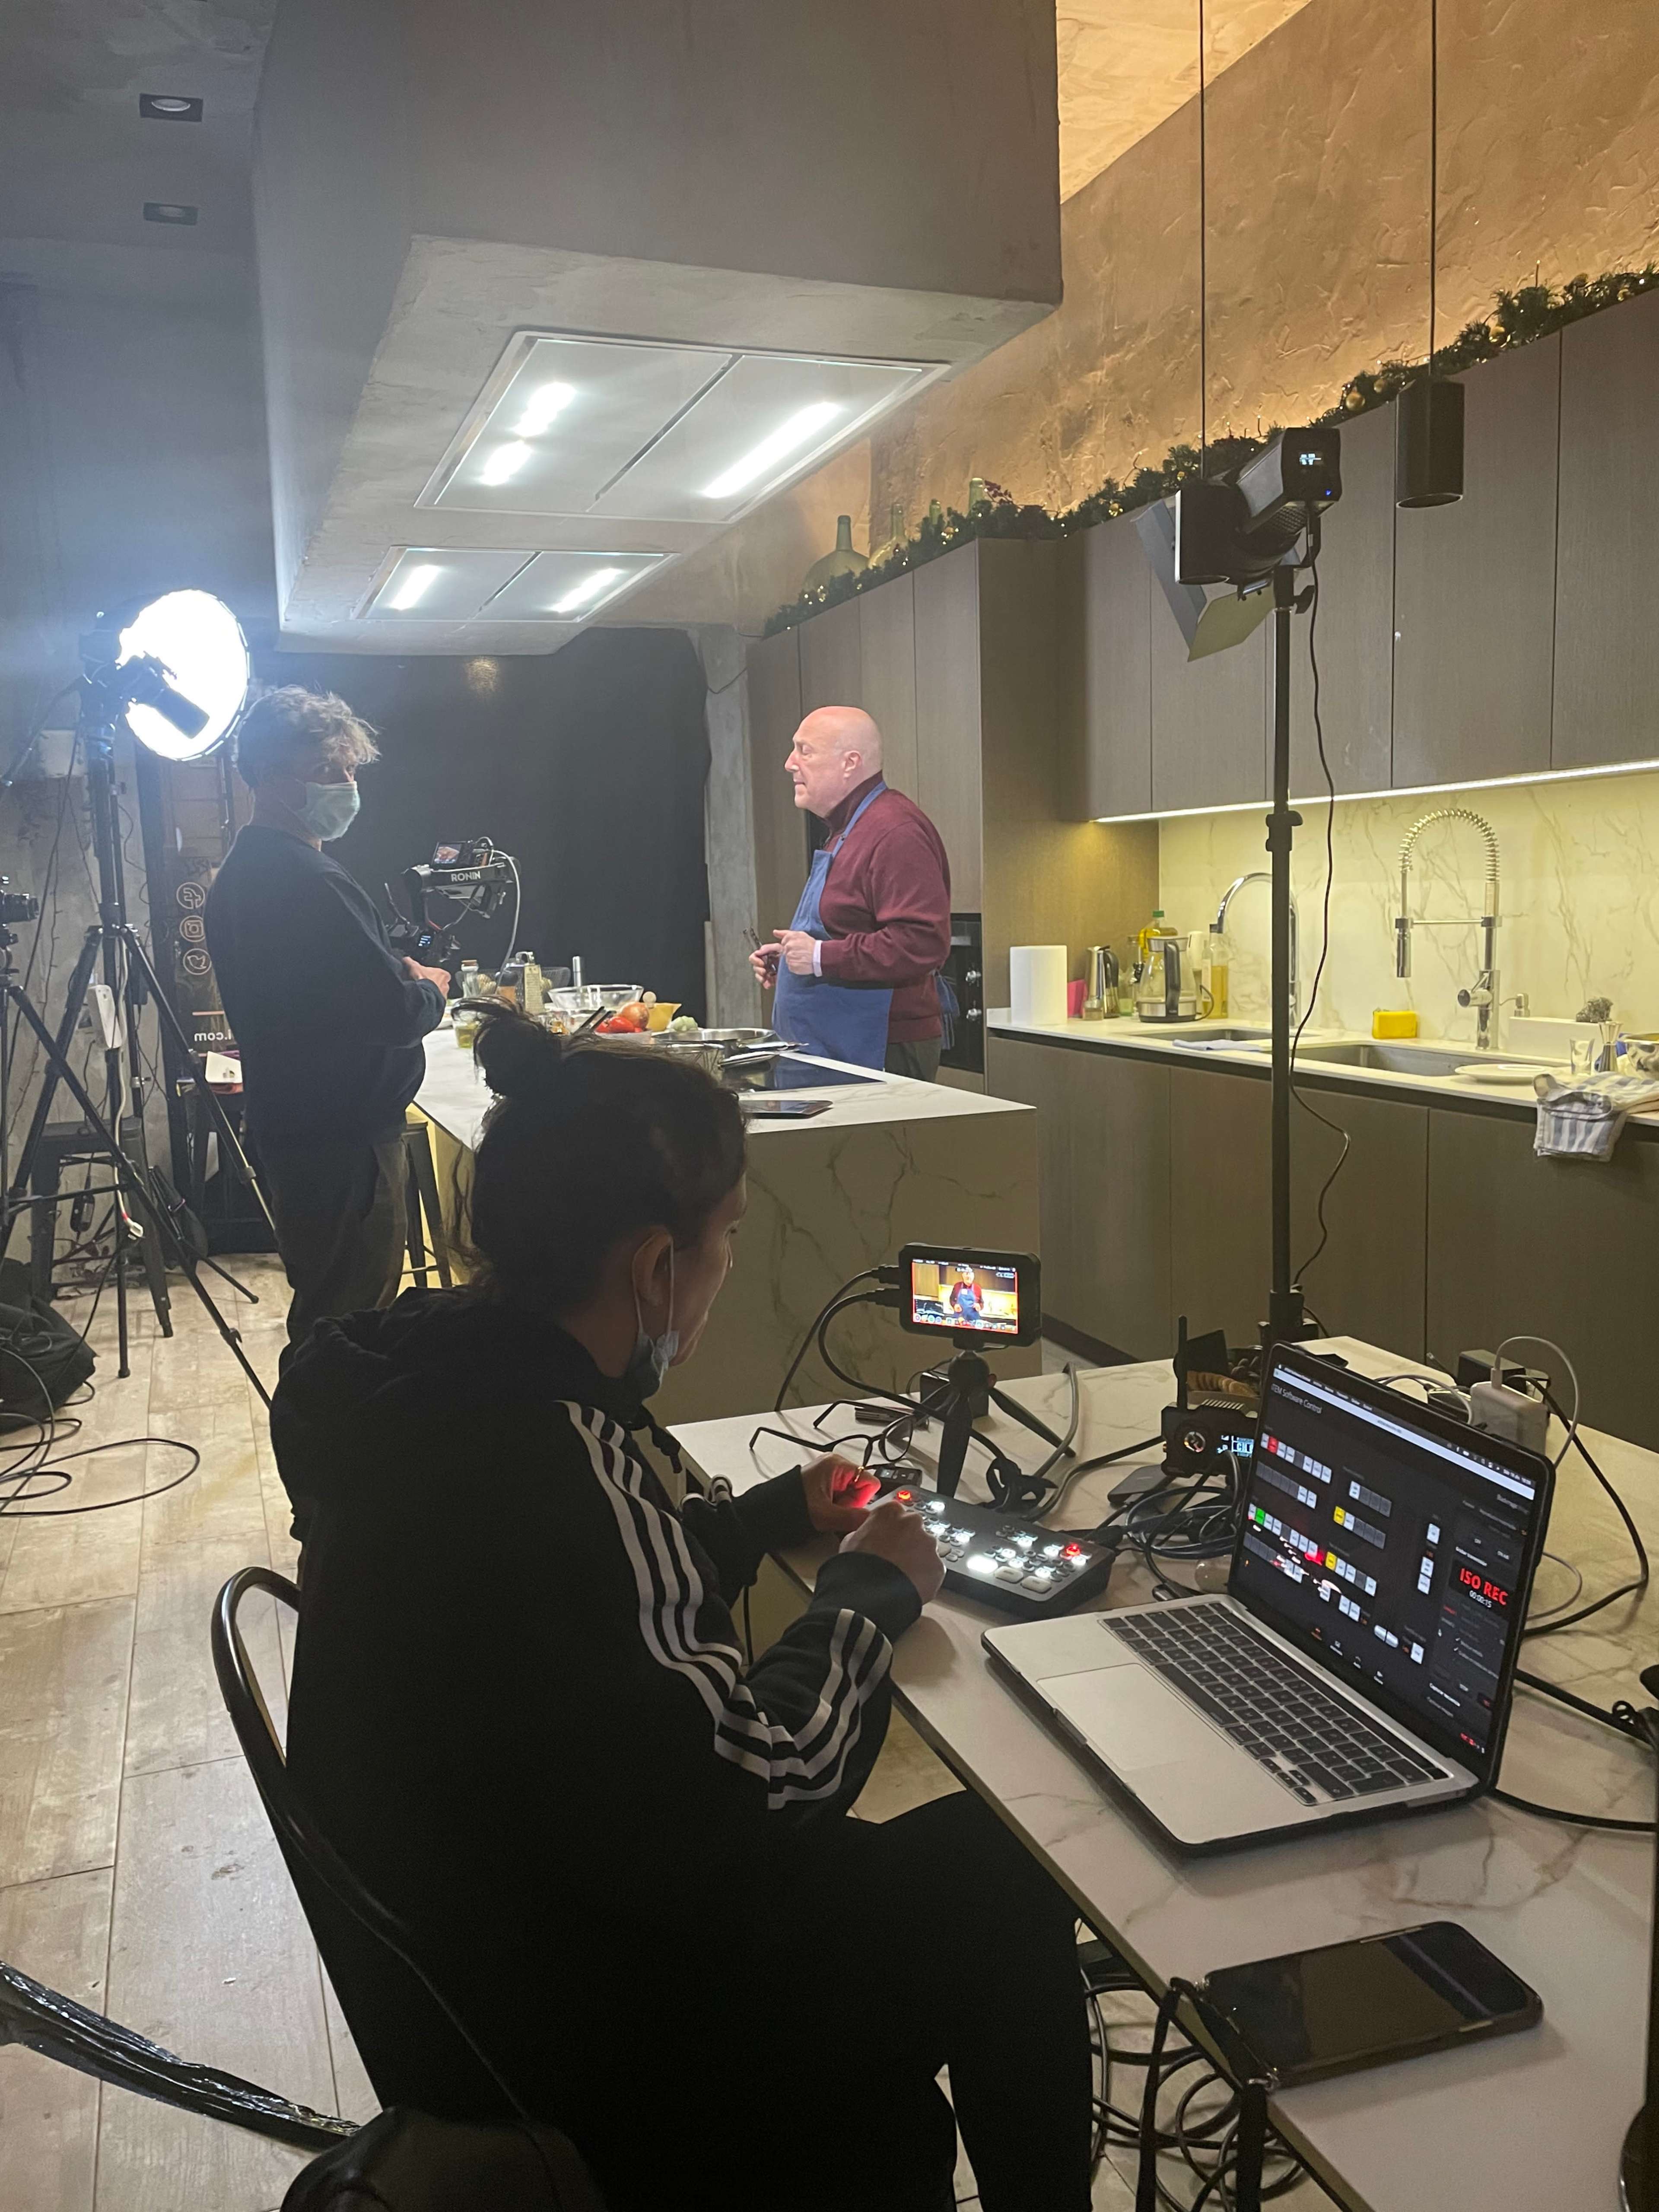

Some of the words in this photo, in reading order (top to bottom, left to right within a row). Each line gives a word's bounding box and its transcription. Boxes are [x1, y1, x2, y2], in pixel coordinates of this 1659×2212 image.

[451, 871, 480, 882] RONIN
[1460, 1568, 1481, 1589] ISO
[1483, 1581, 1508, 1605] REC
